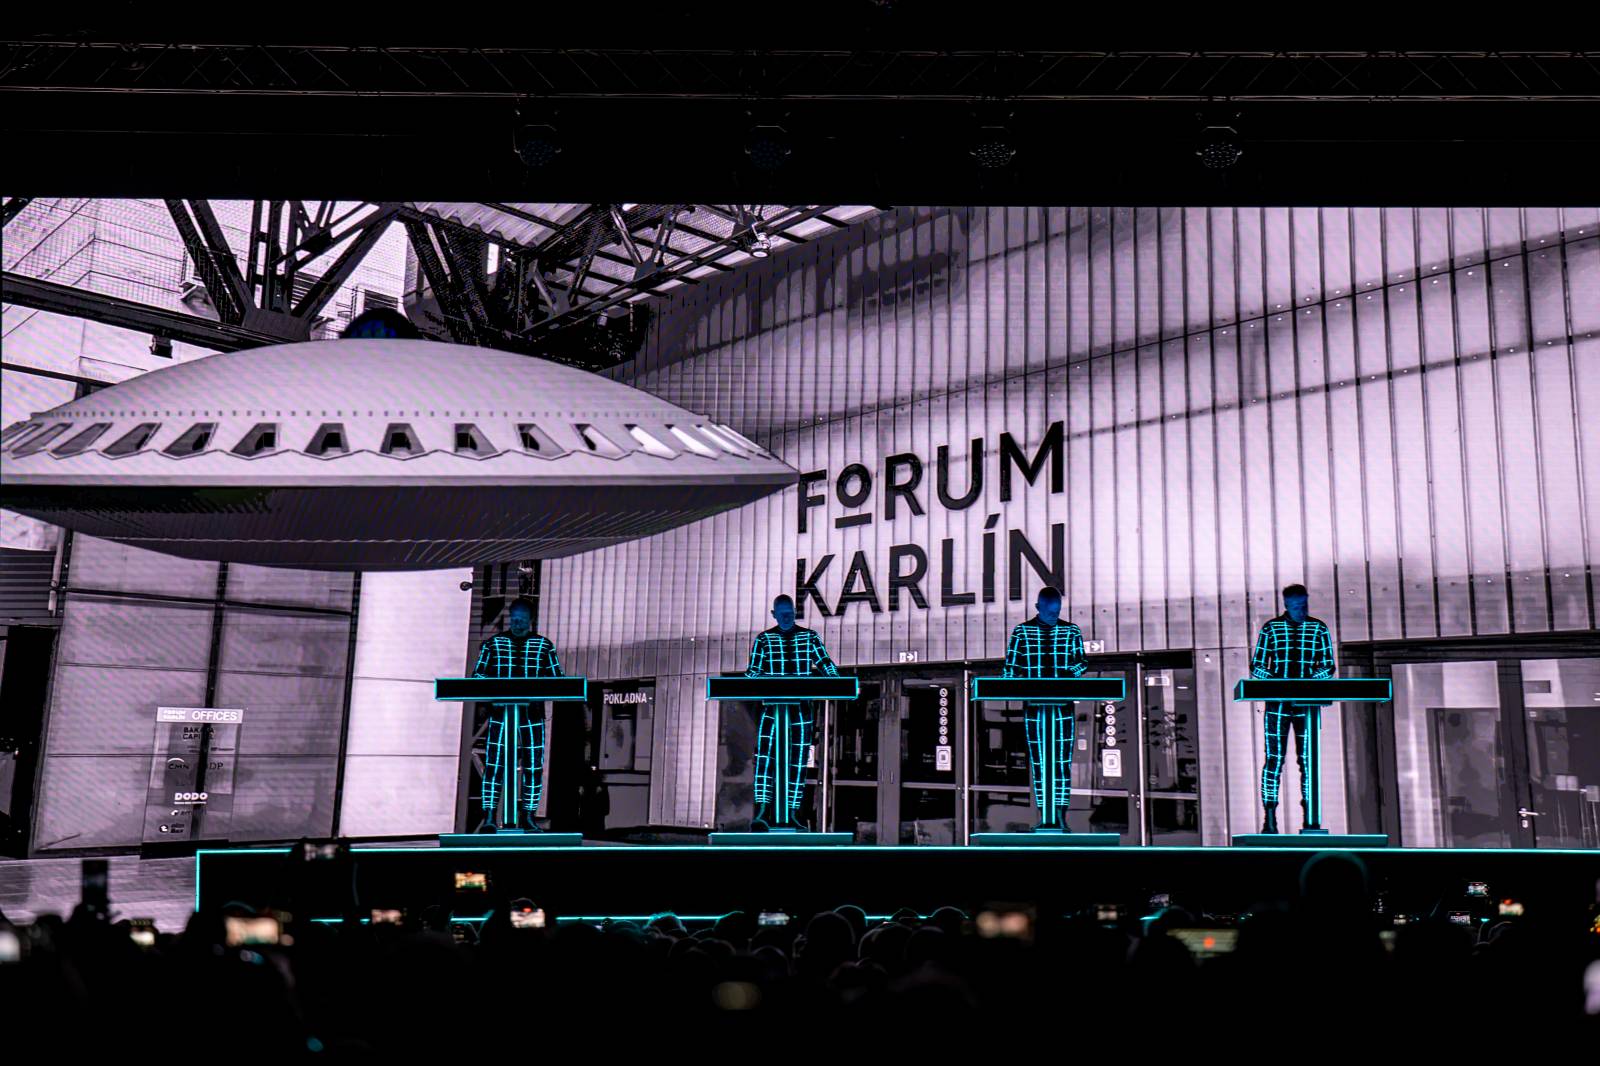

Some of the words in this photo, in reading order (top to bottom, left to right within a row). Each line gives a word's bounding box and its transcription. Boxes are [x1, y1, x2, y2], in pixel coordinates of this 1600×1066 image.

[797, 420, 1065, 534] FORUM
[795, 513, 1065, 619] KARLÍN
[603, 692, 648, 704] POKLADNA
[191, 710, 238, 720] OFFICES
[174, 792, 208, 801] DODO
